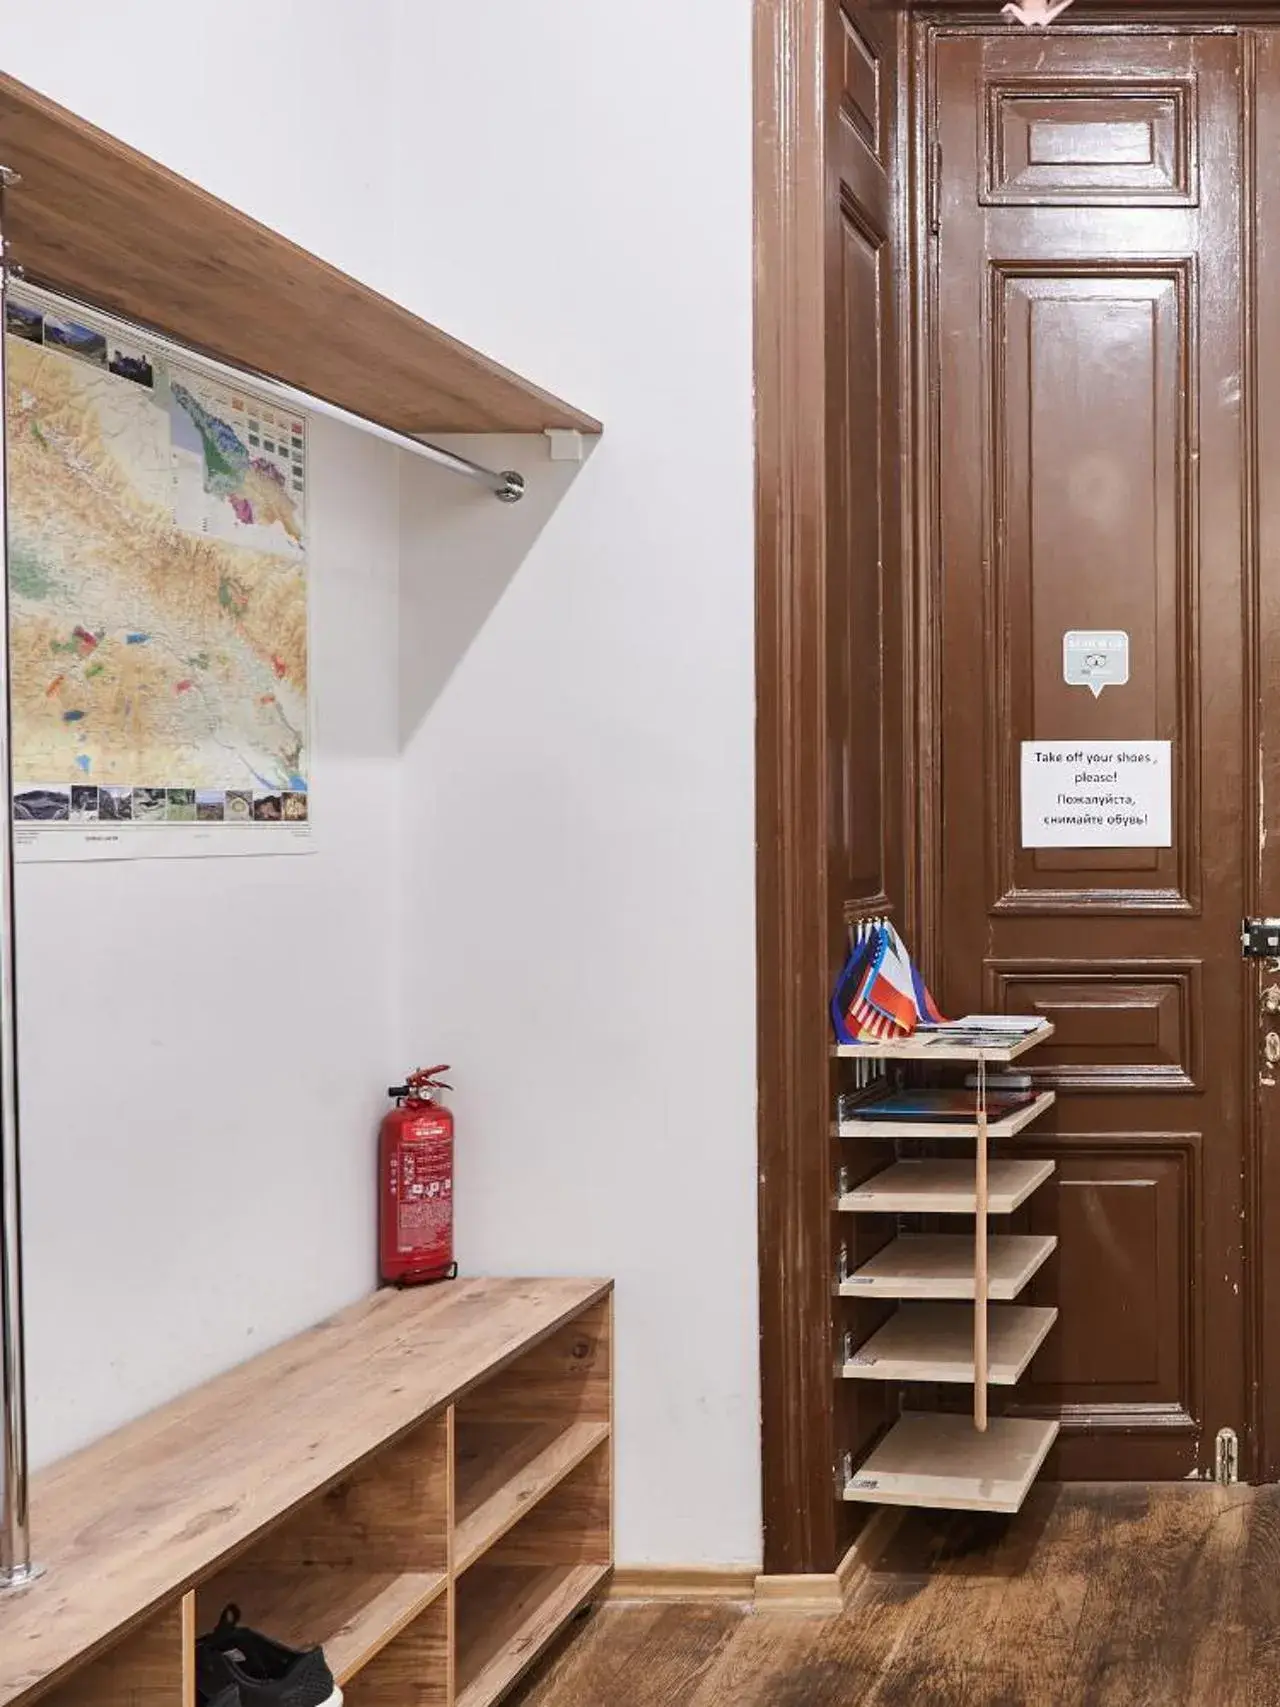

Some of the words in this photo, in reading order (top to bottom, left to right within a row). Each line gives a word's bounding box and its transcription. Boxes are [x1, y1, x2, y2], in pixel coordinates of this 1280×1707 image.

[1035, 752, 1062, 763] Take
[1066, 751, 1083, 763] off
[1086, 754, 1113, 764] your
[1074, 771, 1118, 784] please!
[1057, 793, 1136, 806] Пожалуйста,
[1107, 813, 1148, 826] обувь!
